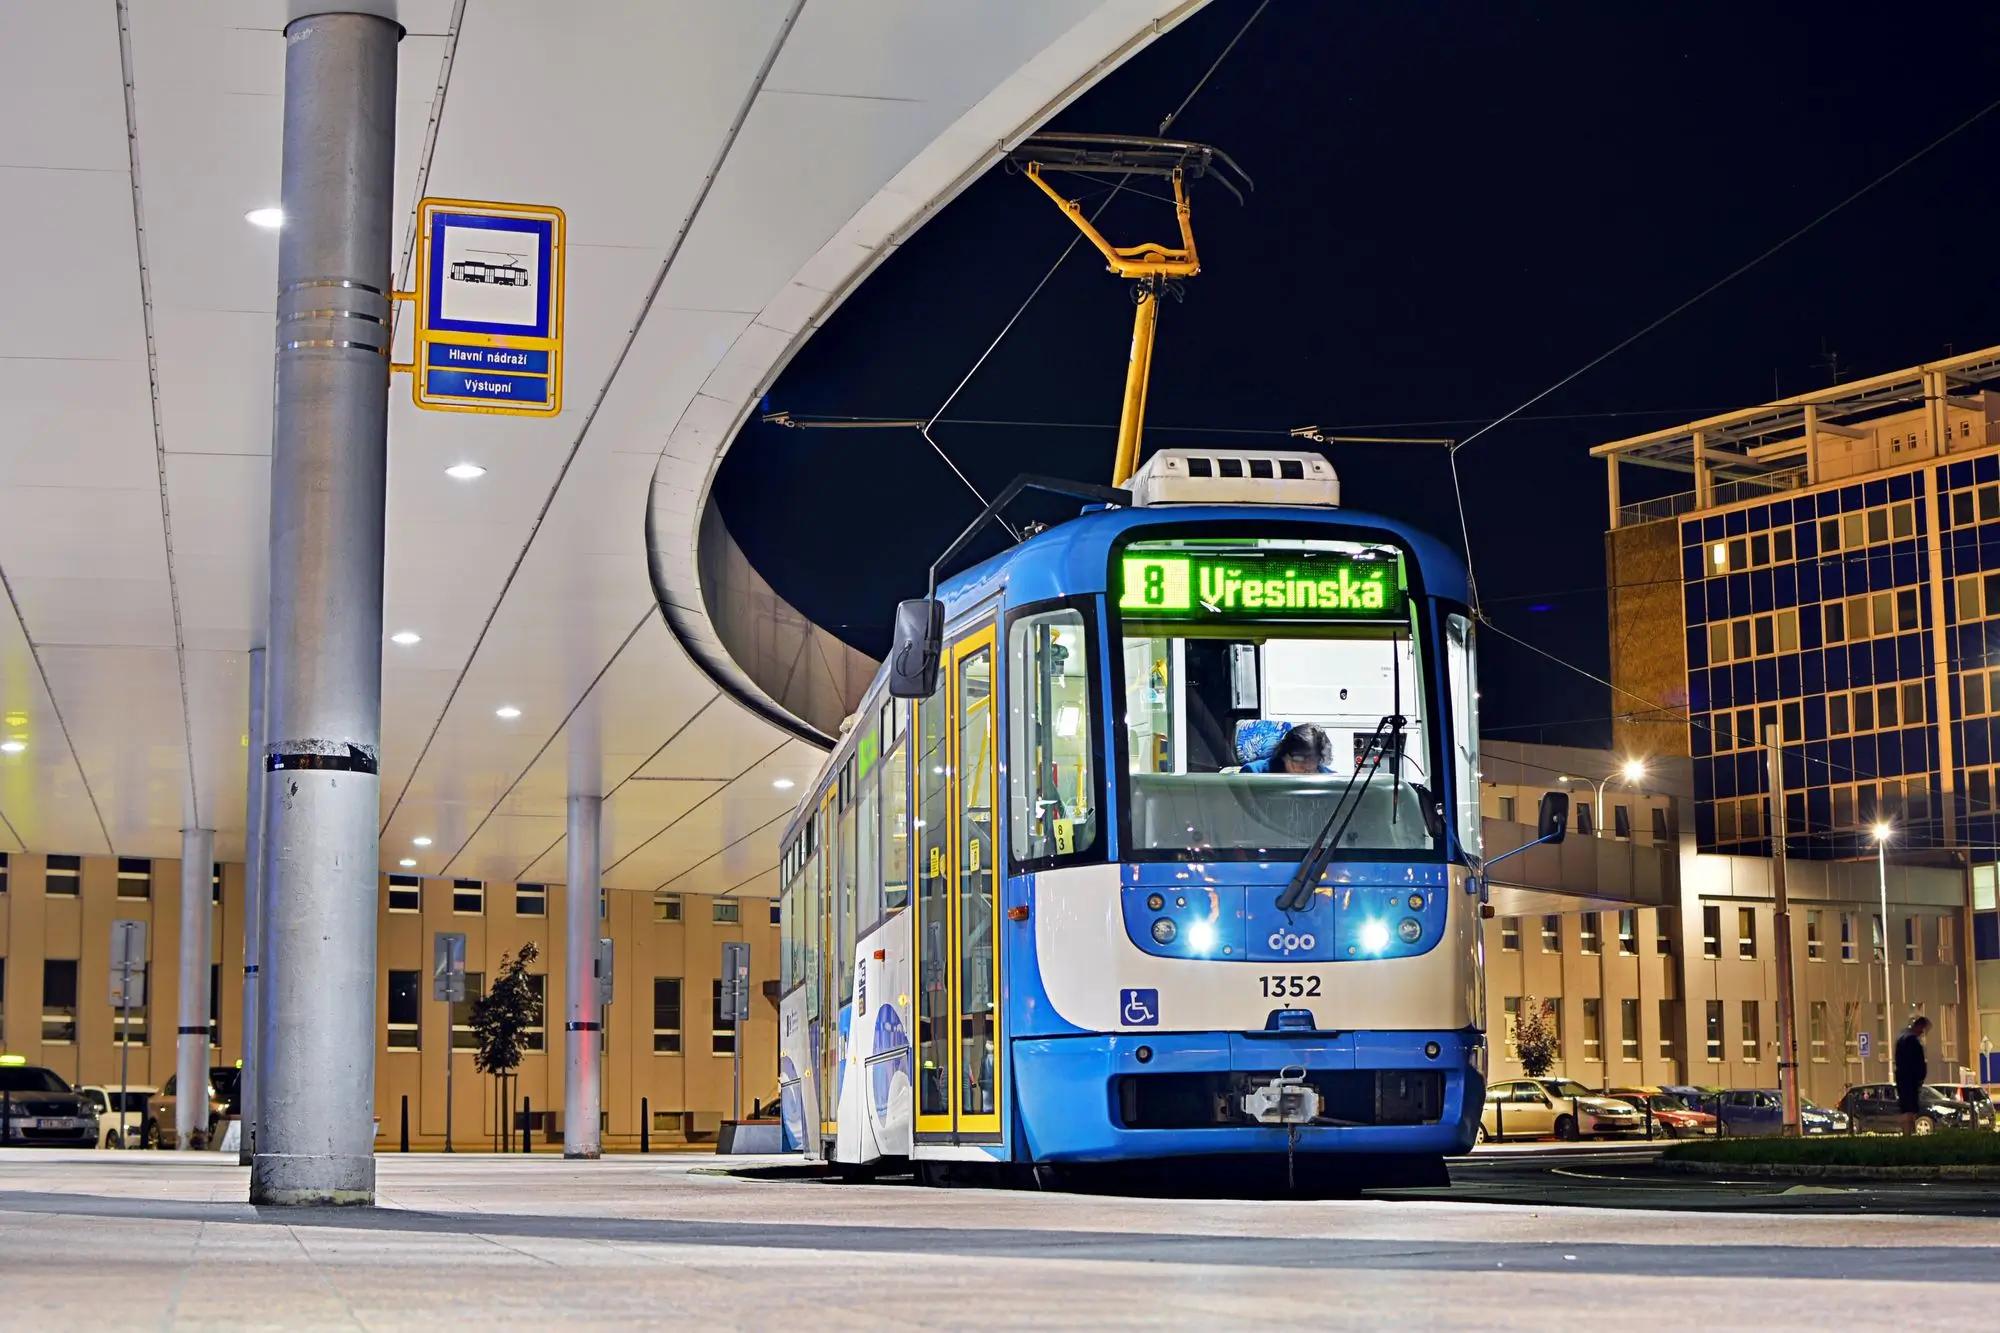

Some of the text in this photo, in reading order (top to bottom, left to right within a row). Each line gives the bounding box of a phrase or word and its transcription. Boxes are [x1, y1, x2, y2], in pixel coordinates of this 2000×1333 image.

[449, 349, 527, 365] Hlavní nádraží
[464, 379, 512, 394] Výstupní
[1144, 565, 1384, 609] 8 Vřesinská
[1058, 825, 1063, 835] 8
[1058, 838, 1065, 850] 3
[1268, 928, 1315, 956] dpo
[1259, 975, 1321, 998] 1352
[1860, 1035, 1867, 1049] P
